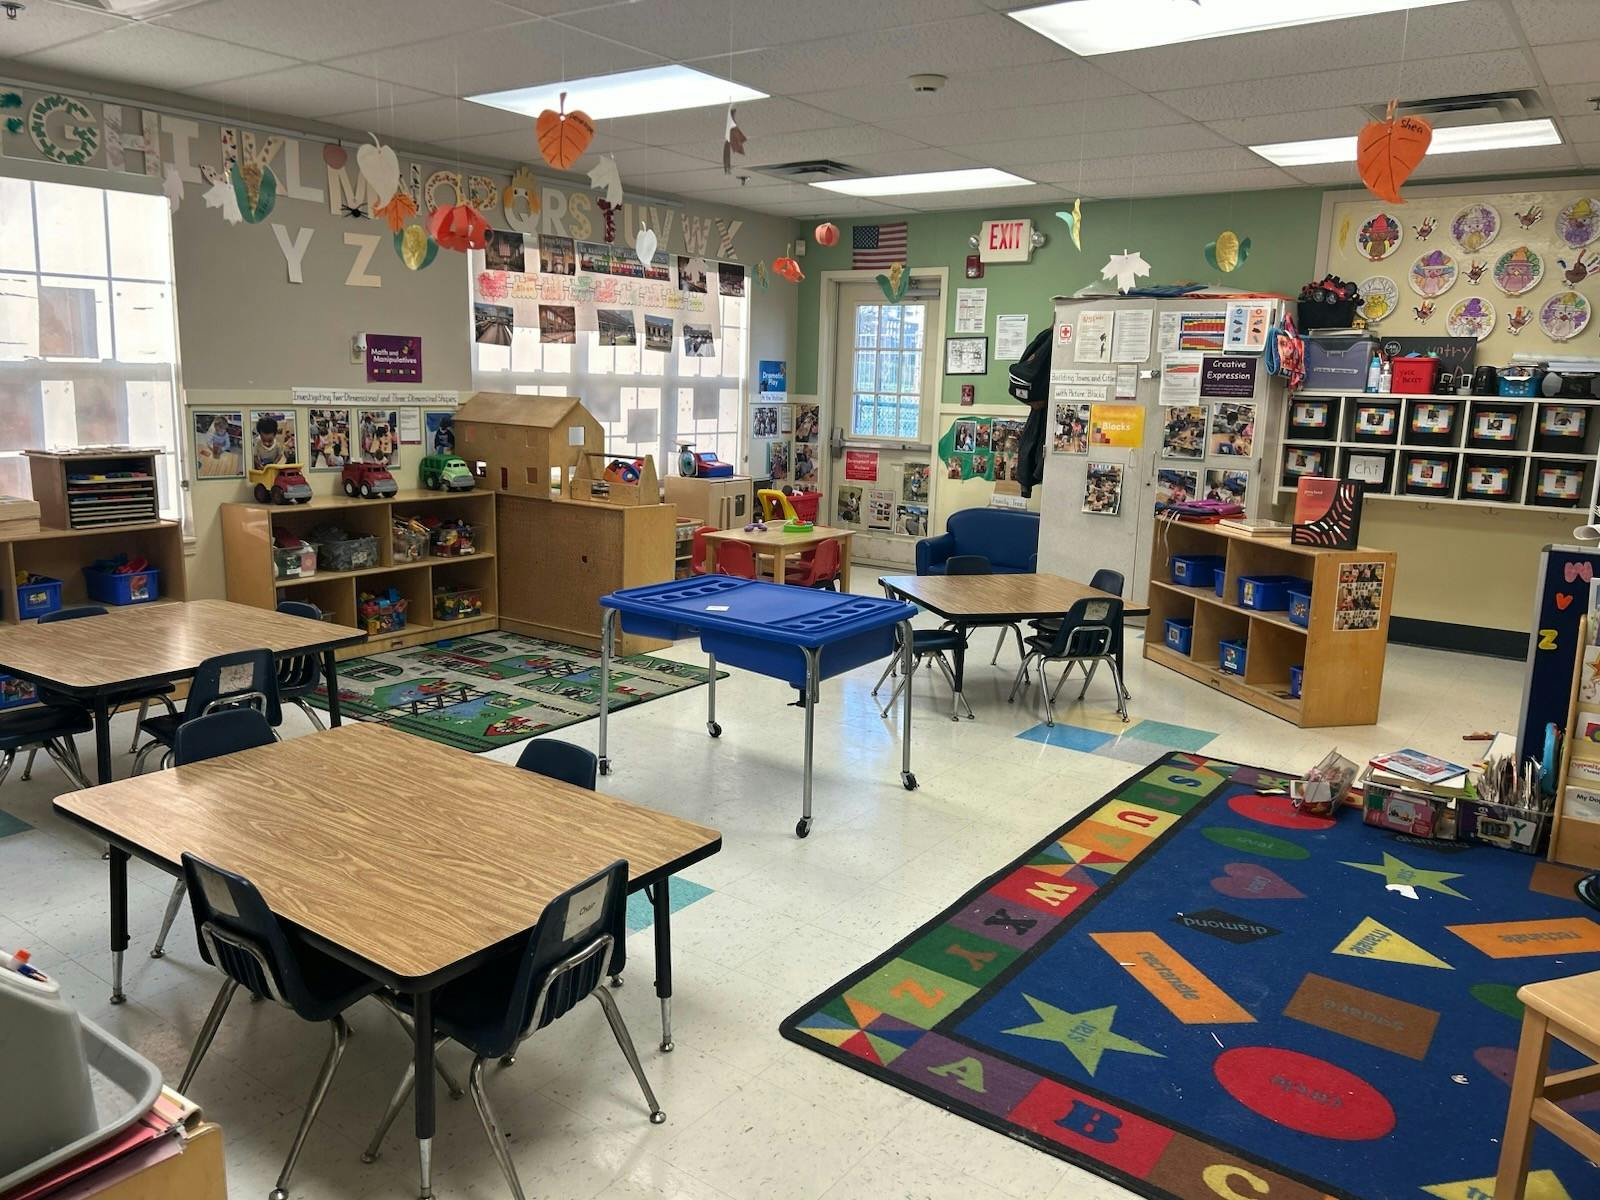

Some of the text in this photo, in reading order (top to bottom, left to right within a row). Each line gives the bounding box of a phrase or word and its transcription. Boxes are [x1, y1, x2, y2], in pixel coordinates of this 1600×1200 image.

[29, 95, 100, 164] G
[102, 102, 162, 177] H
[284, 137, 324, 204] L
[542, 187, 570, 238] R
[568, 192, 593, 241] S
[681, 213, 712, 257] W
[714, 216, 744, 260] X
[989, 222, 1024, 251] EXIT
[270, 222, 383, 288] Y Z
[371, 347, 389, 356] Math
[373, 355, 417, 365] Manipulatives
[762, 370, 784, 379] Dramatic
[1212, 359, 1247, 369] Creative
[767, 378, 778, 386] Play
[1206, 370, 1251, 380] Expression
[1102, 421, 1131, 431] Blocks
[1513, 820, 1527, 837] Y
[983, 907, 1038, 936] X
[1183, 915, 1269, 936] diamond
[945, 944, 998, 972] Y
[888, 977, 946, 1009] Z
[1067, 1019, 1098, 1043] star
[926, 1056, 1271, 1200] A B C
